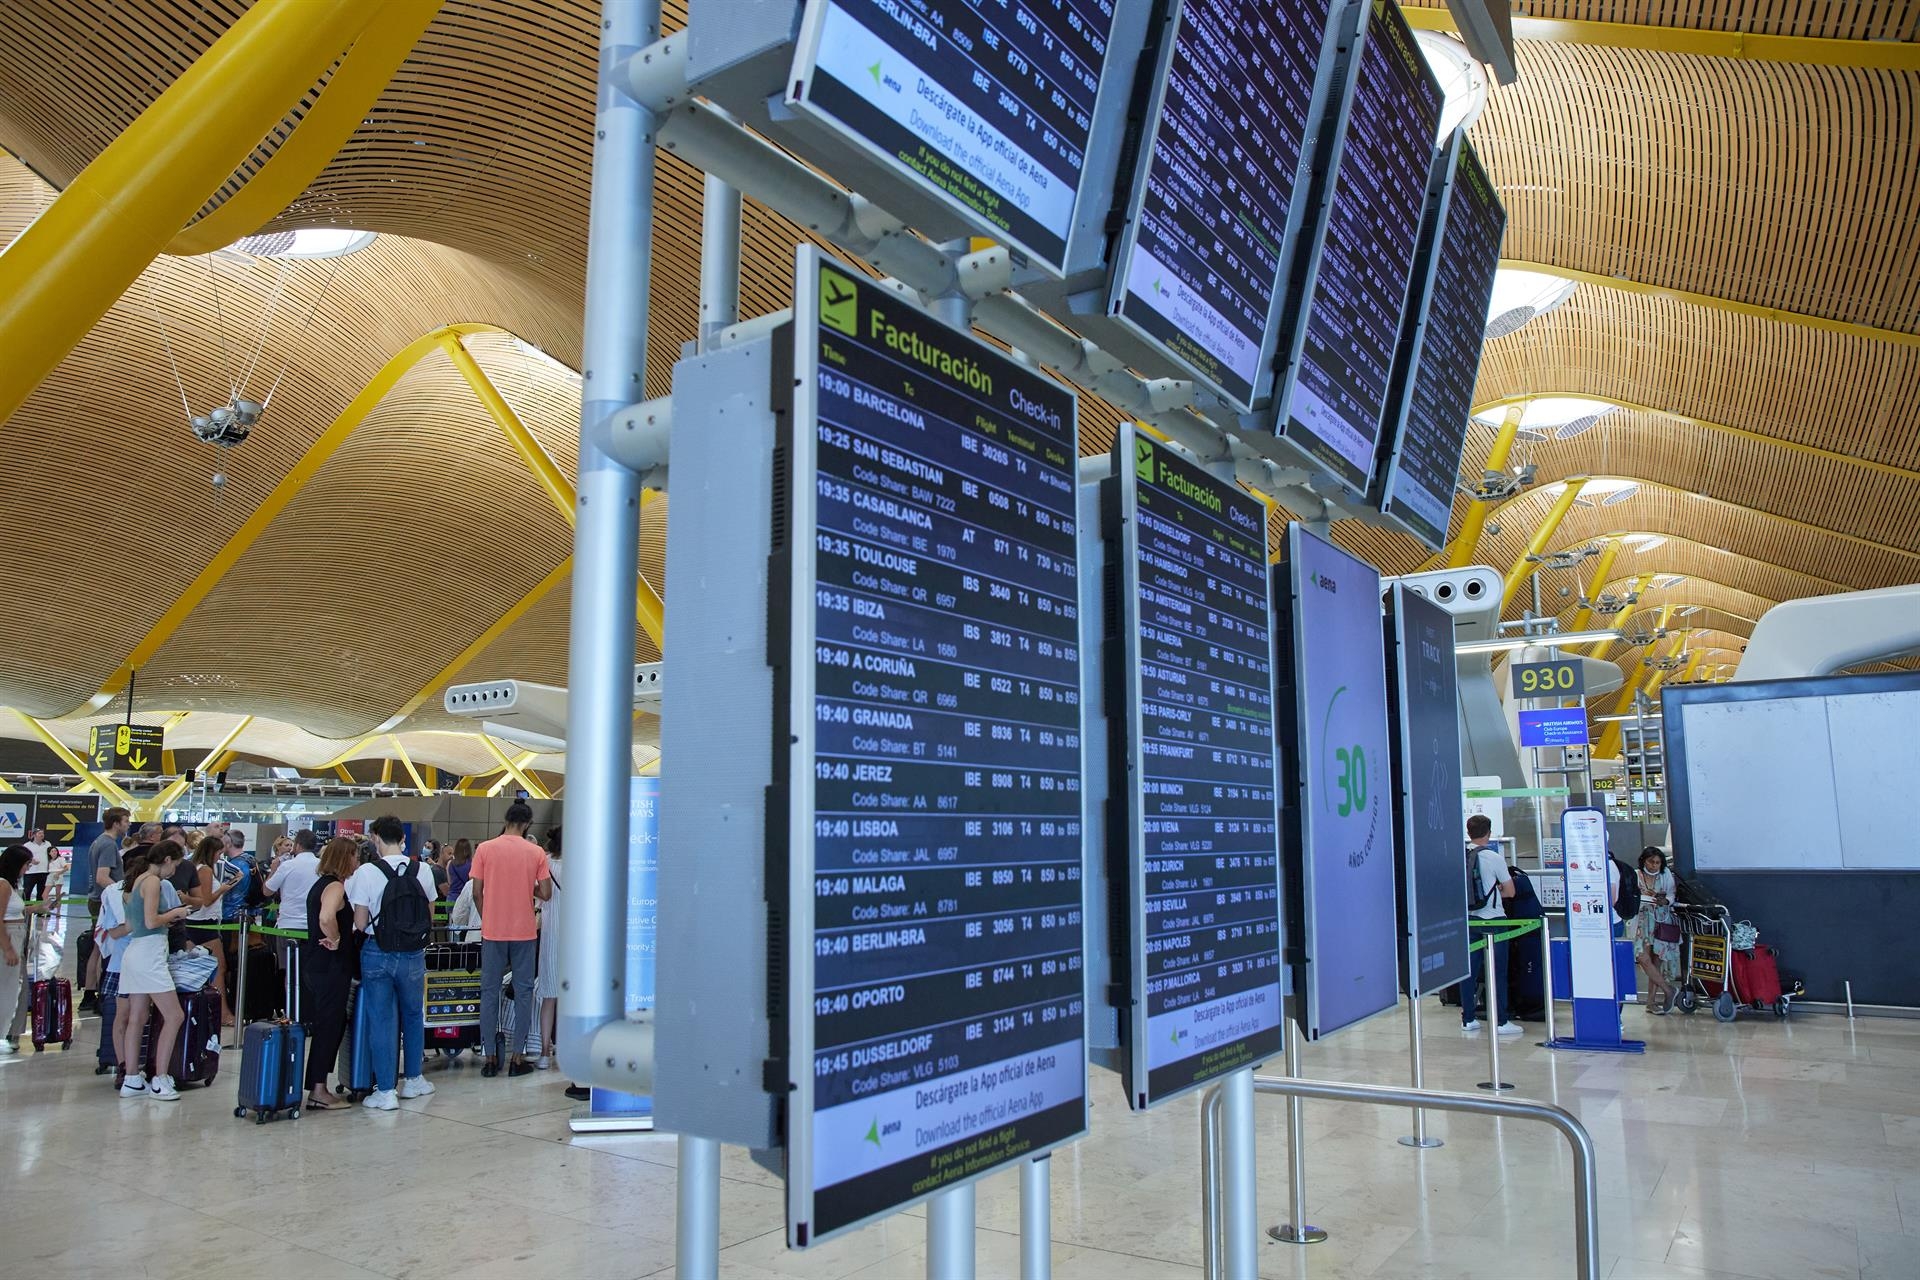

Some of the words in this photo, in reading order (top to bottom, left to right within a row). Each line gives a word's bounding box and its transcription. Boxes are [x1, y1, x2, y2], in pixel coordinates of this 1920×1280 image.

[972, 69, 990, 94] IBE
[1024, 113, 1036, 132] T4
[1042, 128, 1057, 150] 850
[1059, 144, 1067, 158] to
[871, 308, 991, 397] Facturación
[1009, 386, 1060, 431] Check-in
[822, 342, 846, 366] Time
[904, 381, 913, 396] To
[976, 415, 996, 436] Flight
[1007, 430, 1034, 452] Terminal
[818, 372, 849, 399] 19:00
[853, 387, 924, 431] BARCELONA
[961, 434, 977, 453] IBE
[982, 443, 1008, 466] 3026S
[1017, 459, 1026, 474] T4
[818, 425, 849, 451] 19:25
[853, 438, 878, 461] SAN
[881, 449, 942, 485] SEBASTIAN
[962, 481, 977, 498] IBE
[1017, 502, 1027, 517] T4
[1035, 510, 1049, 526] 850
[1053, 518, 1059, 530] to
[853, 464, 878, 485] Code
[880, 474, 908, 496] Share:
[912, 485, 932, 504] BAW
[935, 494, 955, 512] 7222
[1159, 460, 1221, 515] Facturación
[1229, 503, 1257, 533] Check-in
[818, 479, 849, 504] 19:35
[853, 491, 931, 530] CASABLANCA
[962, 528, 975, 544] AT
[994, 538, 1008, 555] 971
[1017, 547, 1027, 561] T4
[1036, 554, 1050, 569] 730
[1053, 560, 1060, 573] to
[818, 534, 849, 557] 19:35
[853, 544, 916, 575] TOULOUSE
[963, 575, 979, 592] IBS
[1320, 574, 1336, 594] aena
[817, 591, 849, 612] 19:35
[853, 599, 884, 620] IBIZA
[963, 624, 979, 640] IBS
[991, 630, 1011, 647] 3812
[817, 647, 849, 668] 19:40
[852, 653, 862, 670] A
[865, 652, 915, 678] CORUÑA
[964, 672, 980, 688] IBE
[991, 677, 1011, 693] 0522
[1521, 666, 1575, 692] 930
[817, 704, 848, 723] 19:40
[852, 709, 912, 730] GRANADA
[964, 722, 980, 736] IBE
[816, 763, 848, 780] 19:40
[852, 765, 891, 781] JEREZ
[964, 771, 980, 785] IBE
[1336, 744, 1366, 817] 30
[1595, 781, 1612, 789] 902
[816, 821, 848, 837] 19:40
[852, 821, 898, 836] LISBOA
[965, 822, 981, 835] IBE
[992, 822, 1013, 835] 3106
[816, 878, 848, 896] 19:40
[852, 875, 905, 894] MALAGA
[965, 871, 981, 886] IBE
[1348, 850, 1364, 868] AÑOS
[1162, 898, 1186, 911] SEVILLA
[815, 937, 848, 956] 19:40
[852, 928, 925, 952] BERLIN-BRA
[965, 922, 981, 937] IBE
[815, 995, 848, 1016] 19:40
[852, 985, 904, 1010] OPORTO
[965, 972, 982, 989] IBE
[993, 967, 1013, 984] 8744
[815, 1053, 848, 1077] 19:45
[851, 1034, 932, 1068] DUSSELDORF
[966, 1023, 982, 1040] IBE
[994, 1015, 1014, 1034] 3134
[916, 1076, 968, 1114] Descárgate
[970, 1073, 978, 1093] la
[981, 1070, 997, 1094] App
[999, 1060, 1023, 1085] oficial
[1025, 1058, 1034, 1077] de
[1036, 1052, 1055, 1074] Aena
[882, 1118, 900, 1137] aena
[915, 1115, 961, 1148] Download
[963, 1111, 975, 1131] the
[977, 1100, 1005, 1126] official
[1007, 1093, 1028, 1116] Aena
[1030, 1089, 1043, 1111] App
